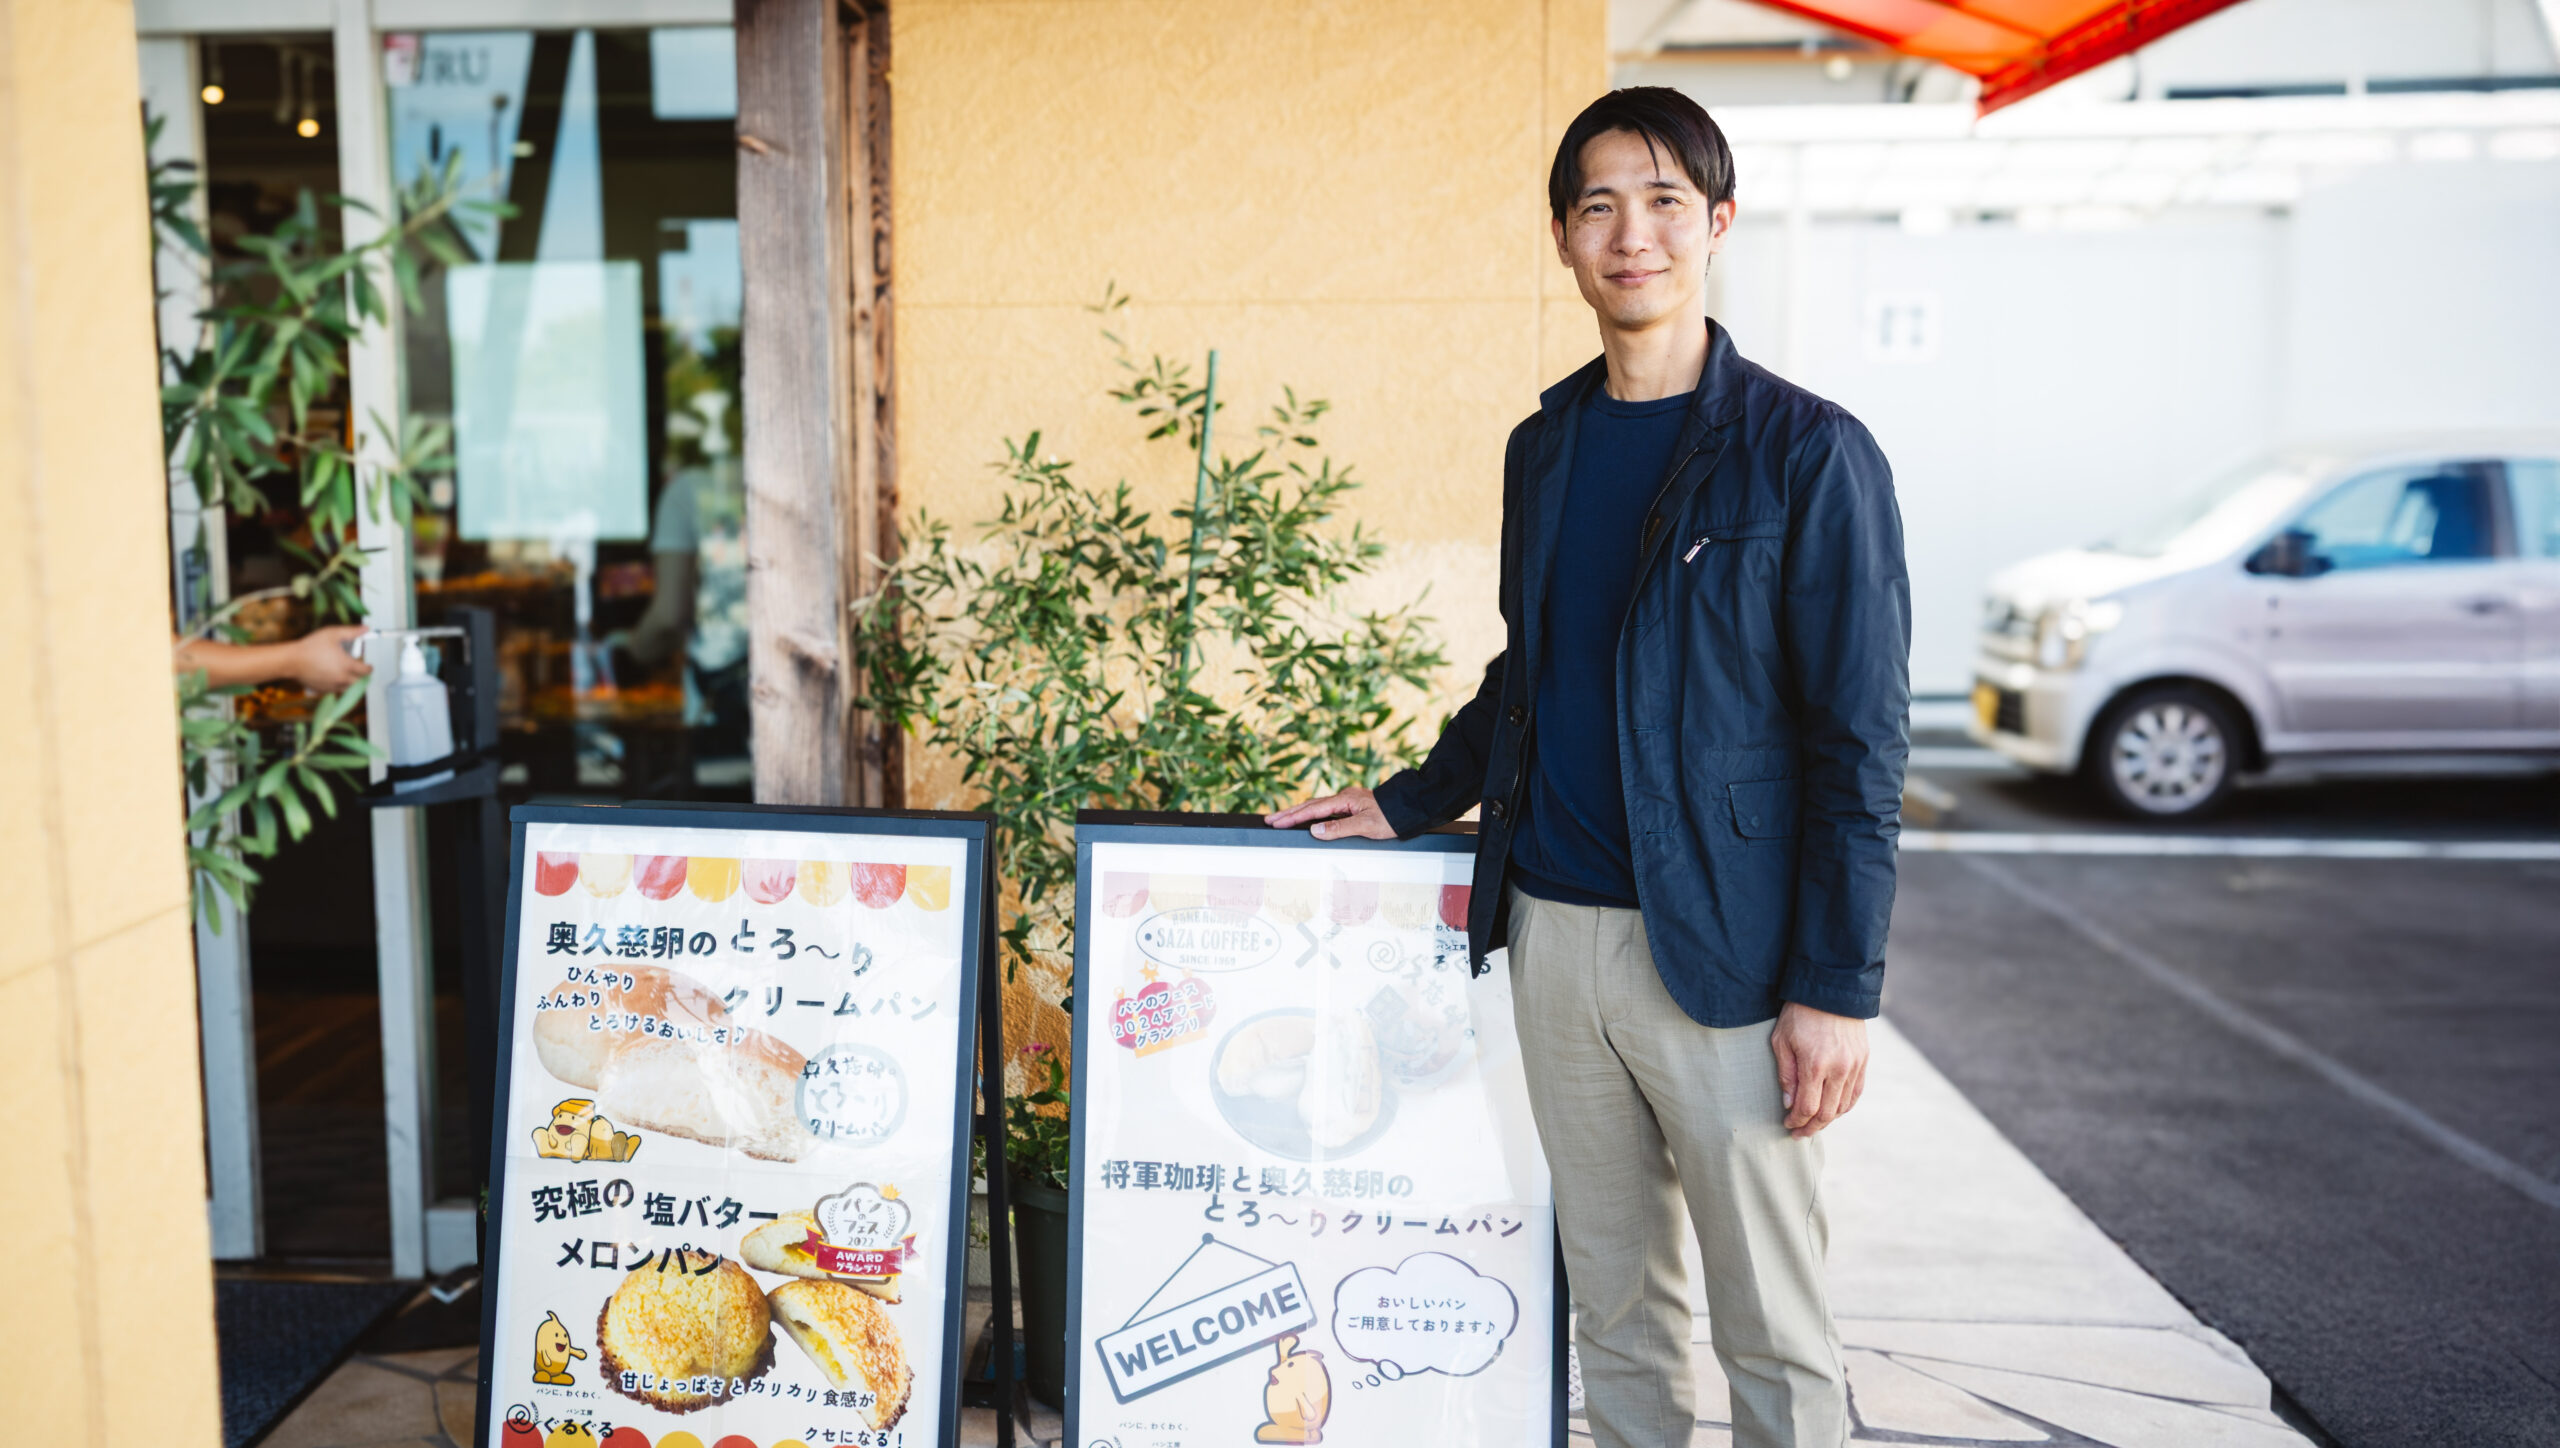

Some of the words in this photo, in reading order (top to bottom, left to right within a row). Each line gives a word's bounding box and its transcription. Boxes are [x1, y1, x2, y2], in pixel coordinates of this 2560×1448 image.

[1156, 928, 1195, 949] SAZA
[1201, 930, 1261, 952] COFFEE
[1179, 954, 1210, 966] SINCE
[567, 966, 635, 991] ひんやり
[536, 991, 601, 1010] ふんわり
[723, 985, 938, 1021] クリームパン
[1100, 1159, 1415, 1199] 将軍珈琲と奥久慈卵の
[556, 1237, 724, 1277] メロンパン
[835, 1250, 885, 1263] AWARD
[836, 1261, 882, 1274] グランプリ
[1377, 1296, 1467, 1311] おいしいパン
[1114, 1282, 1302, 1378] WELCOME
[543, 1416, 615, 1438] ぐるぐる
